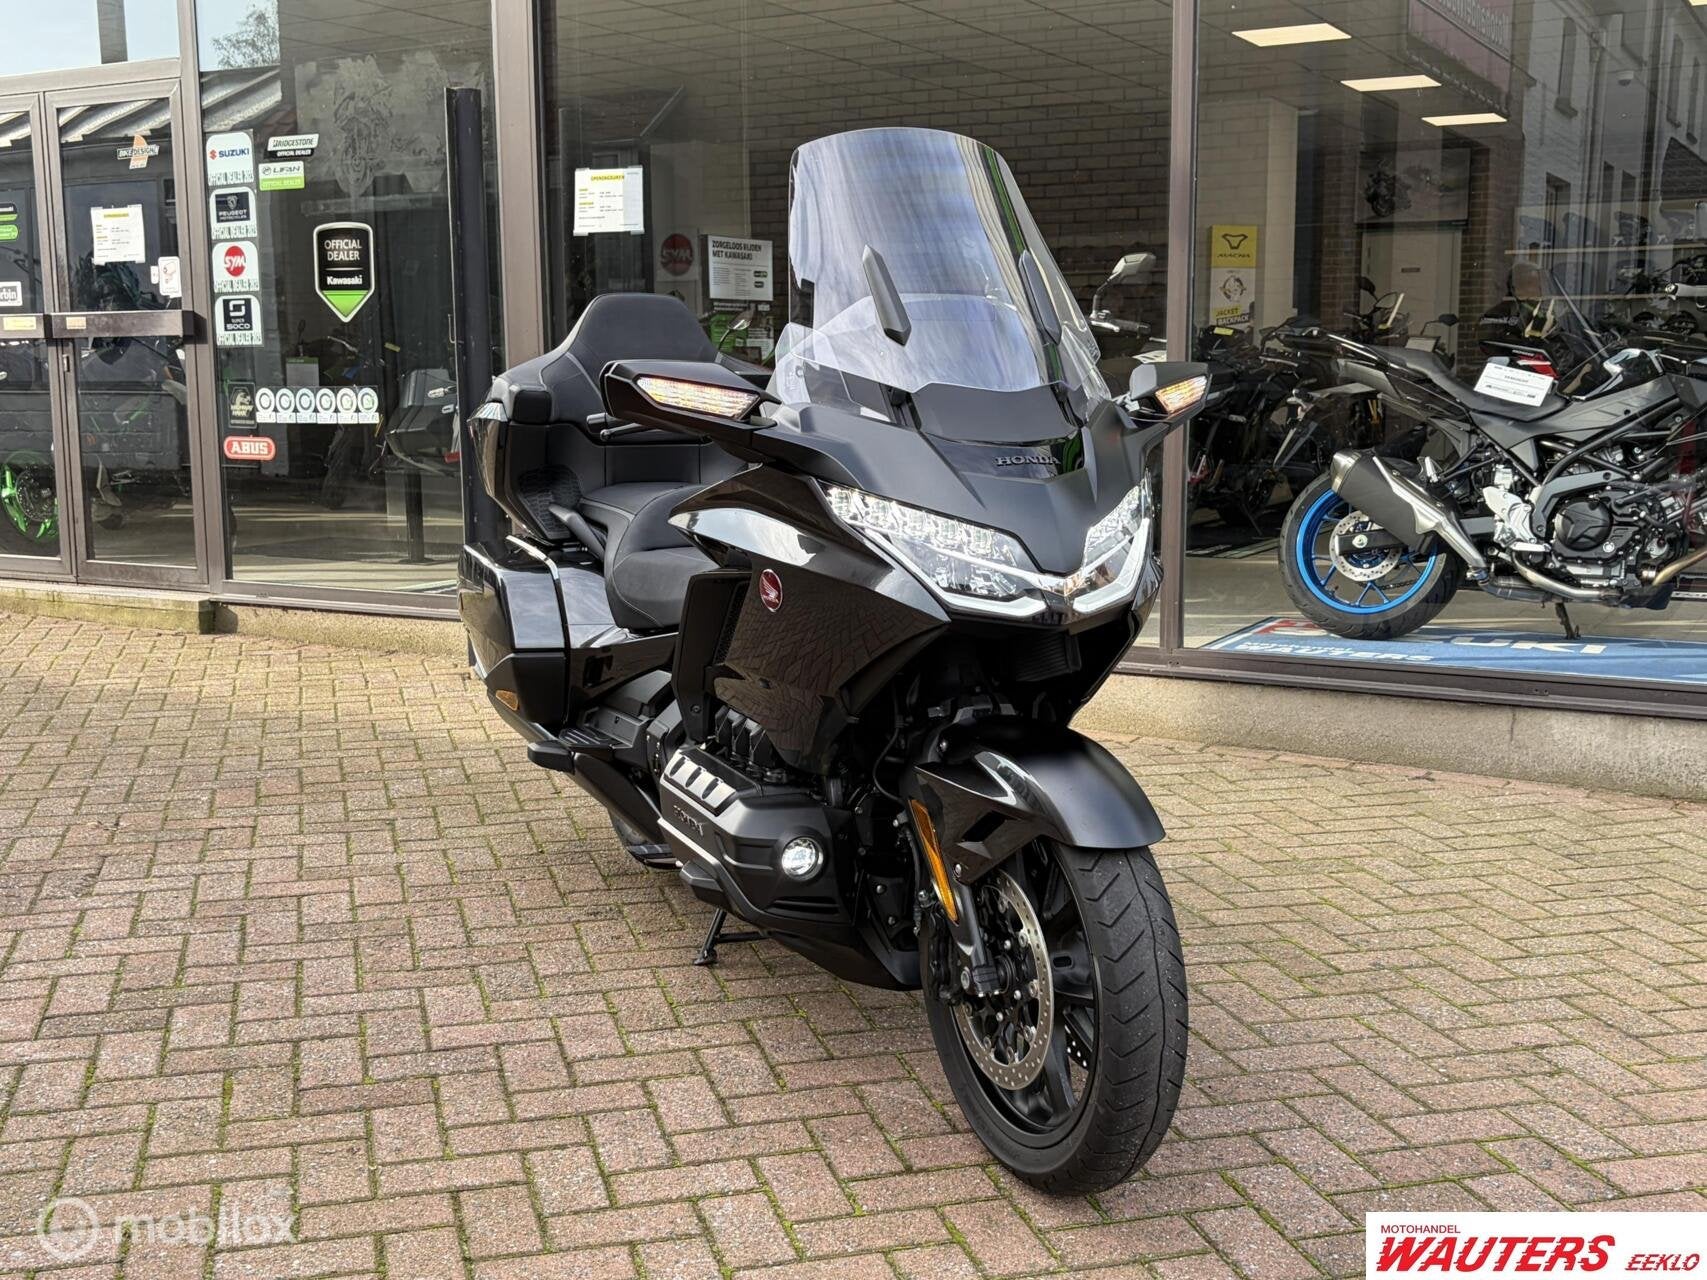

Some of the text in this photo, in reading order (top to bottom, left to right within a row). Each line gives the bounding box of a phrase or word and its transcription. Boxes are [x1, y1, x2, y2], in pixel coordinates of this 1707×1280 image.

[273, 138, 314, 147] BRIDGESTONE
[218, 148, 250, 158] SUZUKI
[324, 239, 362, 250] OFFICIAL
[712, 240, 762, 252] ZORGELOOS RIJDEN
[327, 250, 360, 261] DEALER
[712, 250, 753, 260] MET KAWASAKI
[225, 256, 246, 271] SYM
[326, 274, 363, 285] Kawasaki
[1216, 306, 1240, 317] JACKET
[231, 442, 269, 455] ABUS
[995, 455, 1061, 466] HONDA
[1235, 645, 1434, 661] WAUTERS
